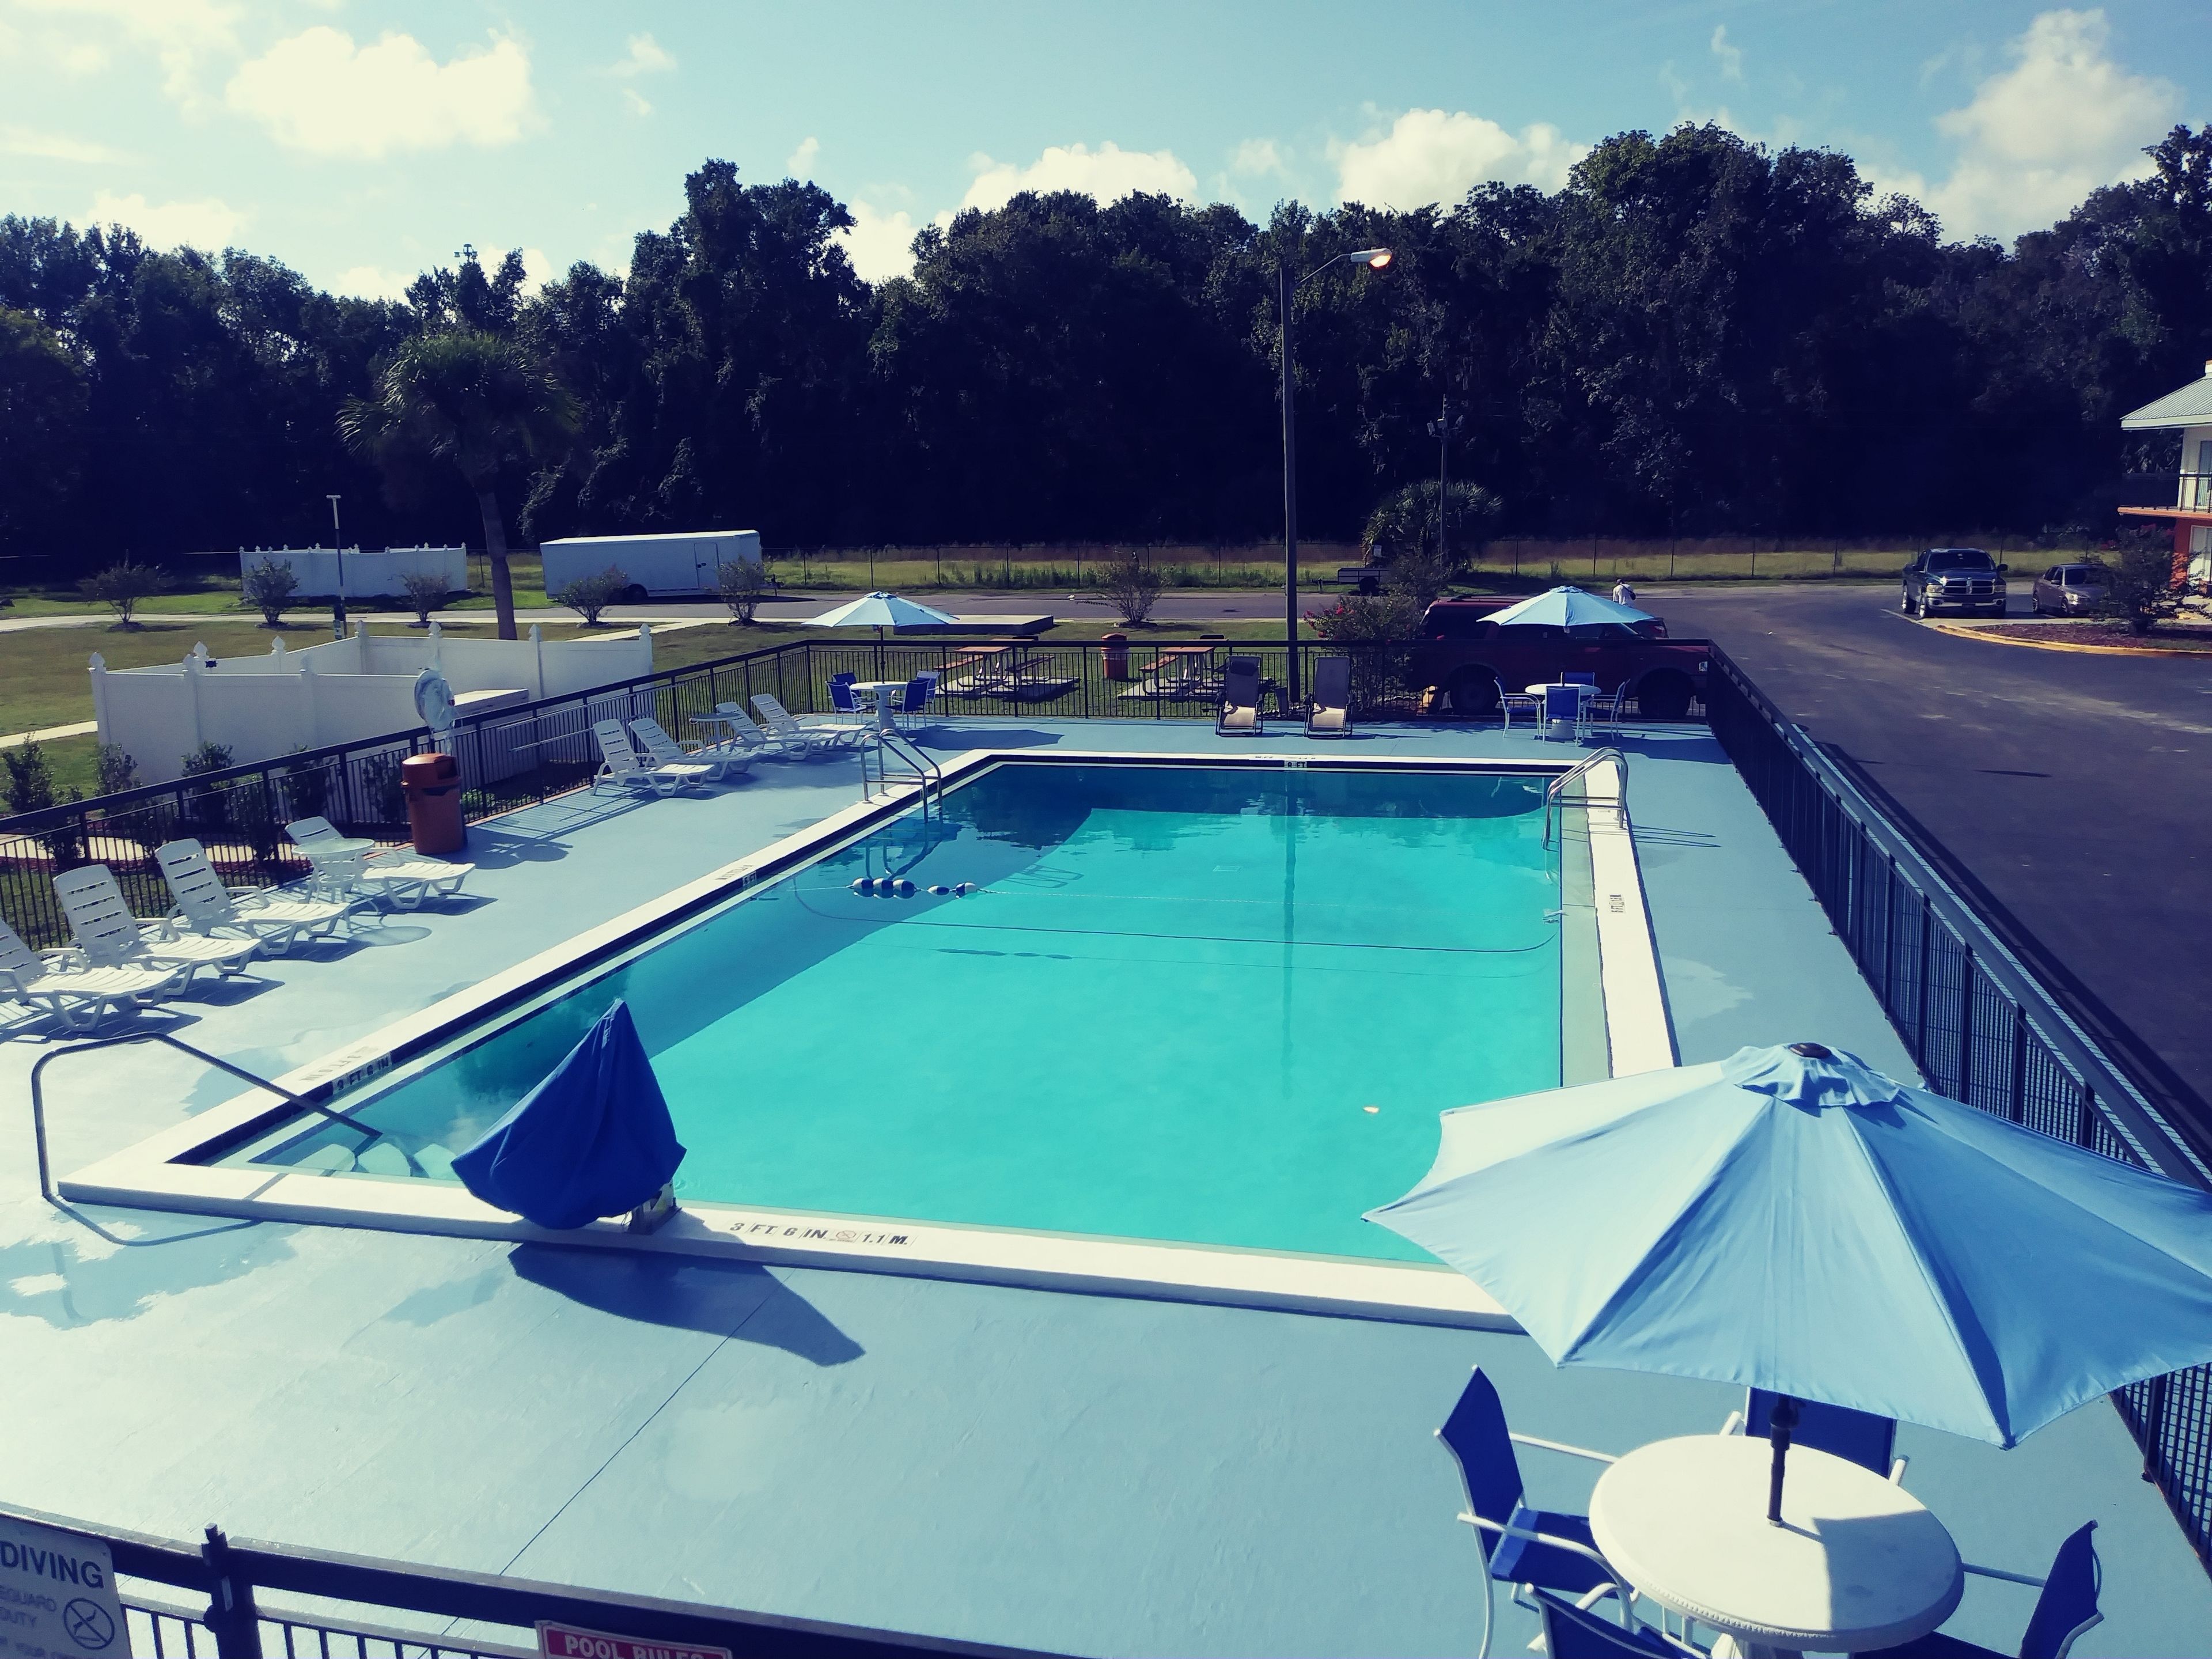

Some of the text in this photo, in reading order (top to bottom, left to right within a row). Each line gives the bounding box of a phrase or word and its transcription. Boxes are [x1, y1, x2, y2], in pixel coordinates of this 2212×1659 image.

[729, 1222, 745, 1231] 3
[0, 1540, 104, 1589] DIVING
[564, 1634, 624, 1659] POOL
